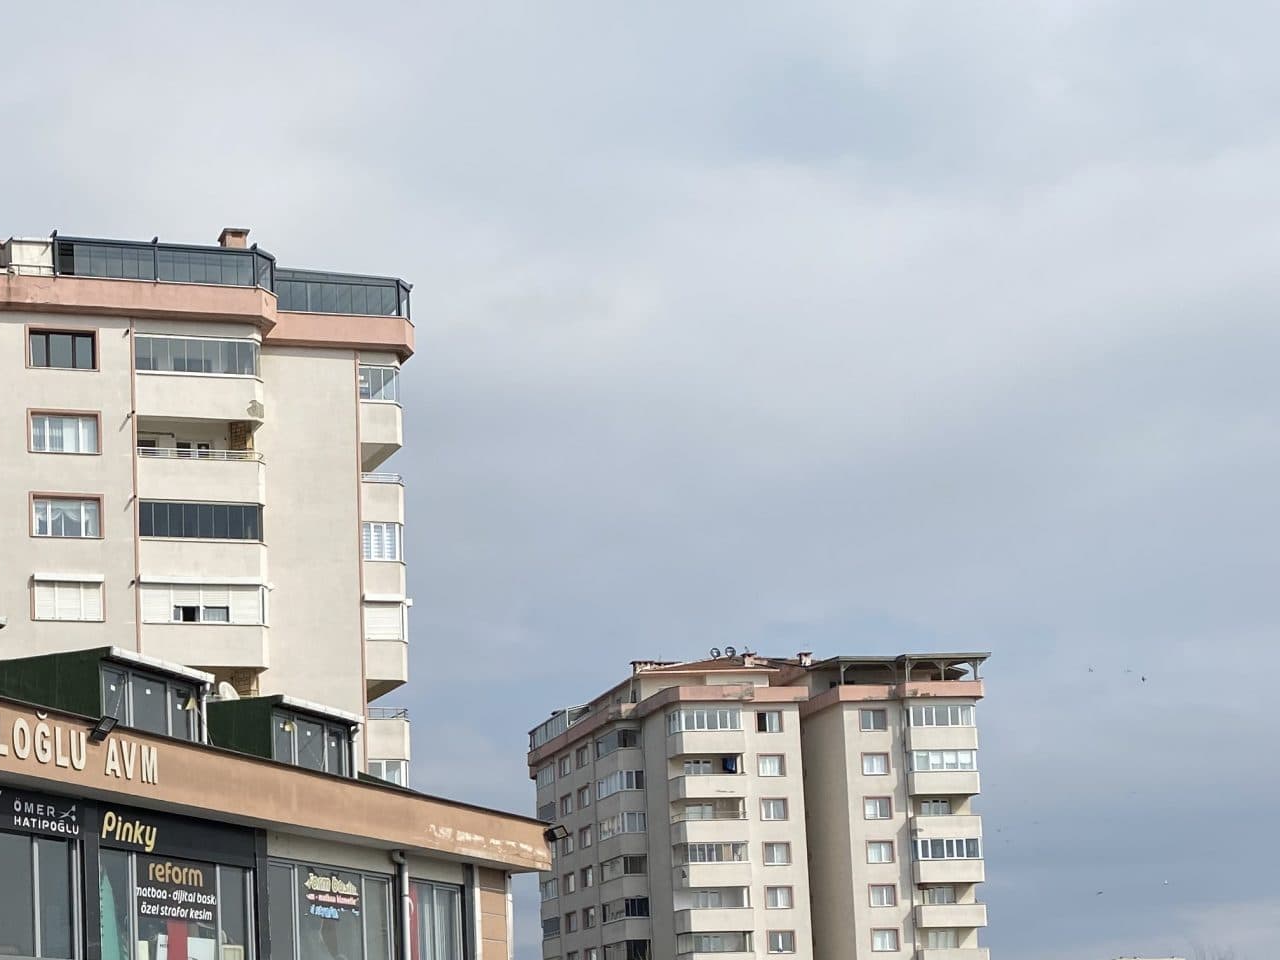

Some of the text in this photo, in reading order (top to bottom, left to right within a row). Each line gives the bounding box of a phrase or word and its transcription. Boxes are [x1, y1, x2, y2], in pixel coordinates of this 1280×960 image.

[104, 737, 159, 785] AVM
[13, 797, 56, 818] ÖMER
[13, 815, 79, 836] HATİPOĞLU
[101, 810, 158, 853] Pinky
[148, 861, 204, 888] reform
[140, 901, 212, 921] özel strafor kesim
